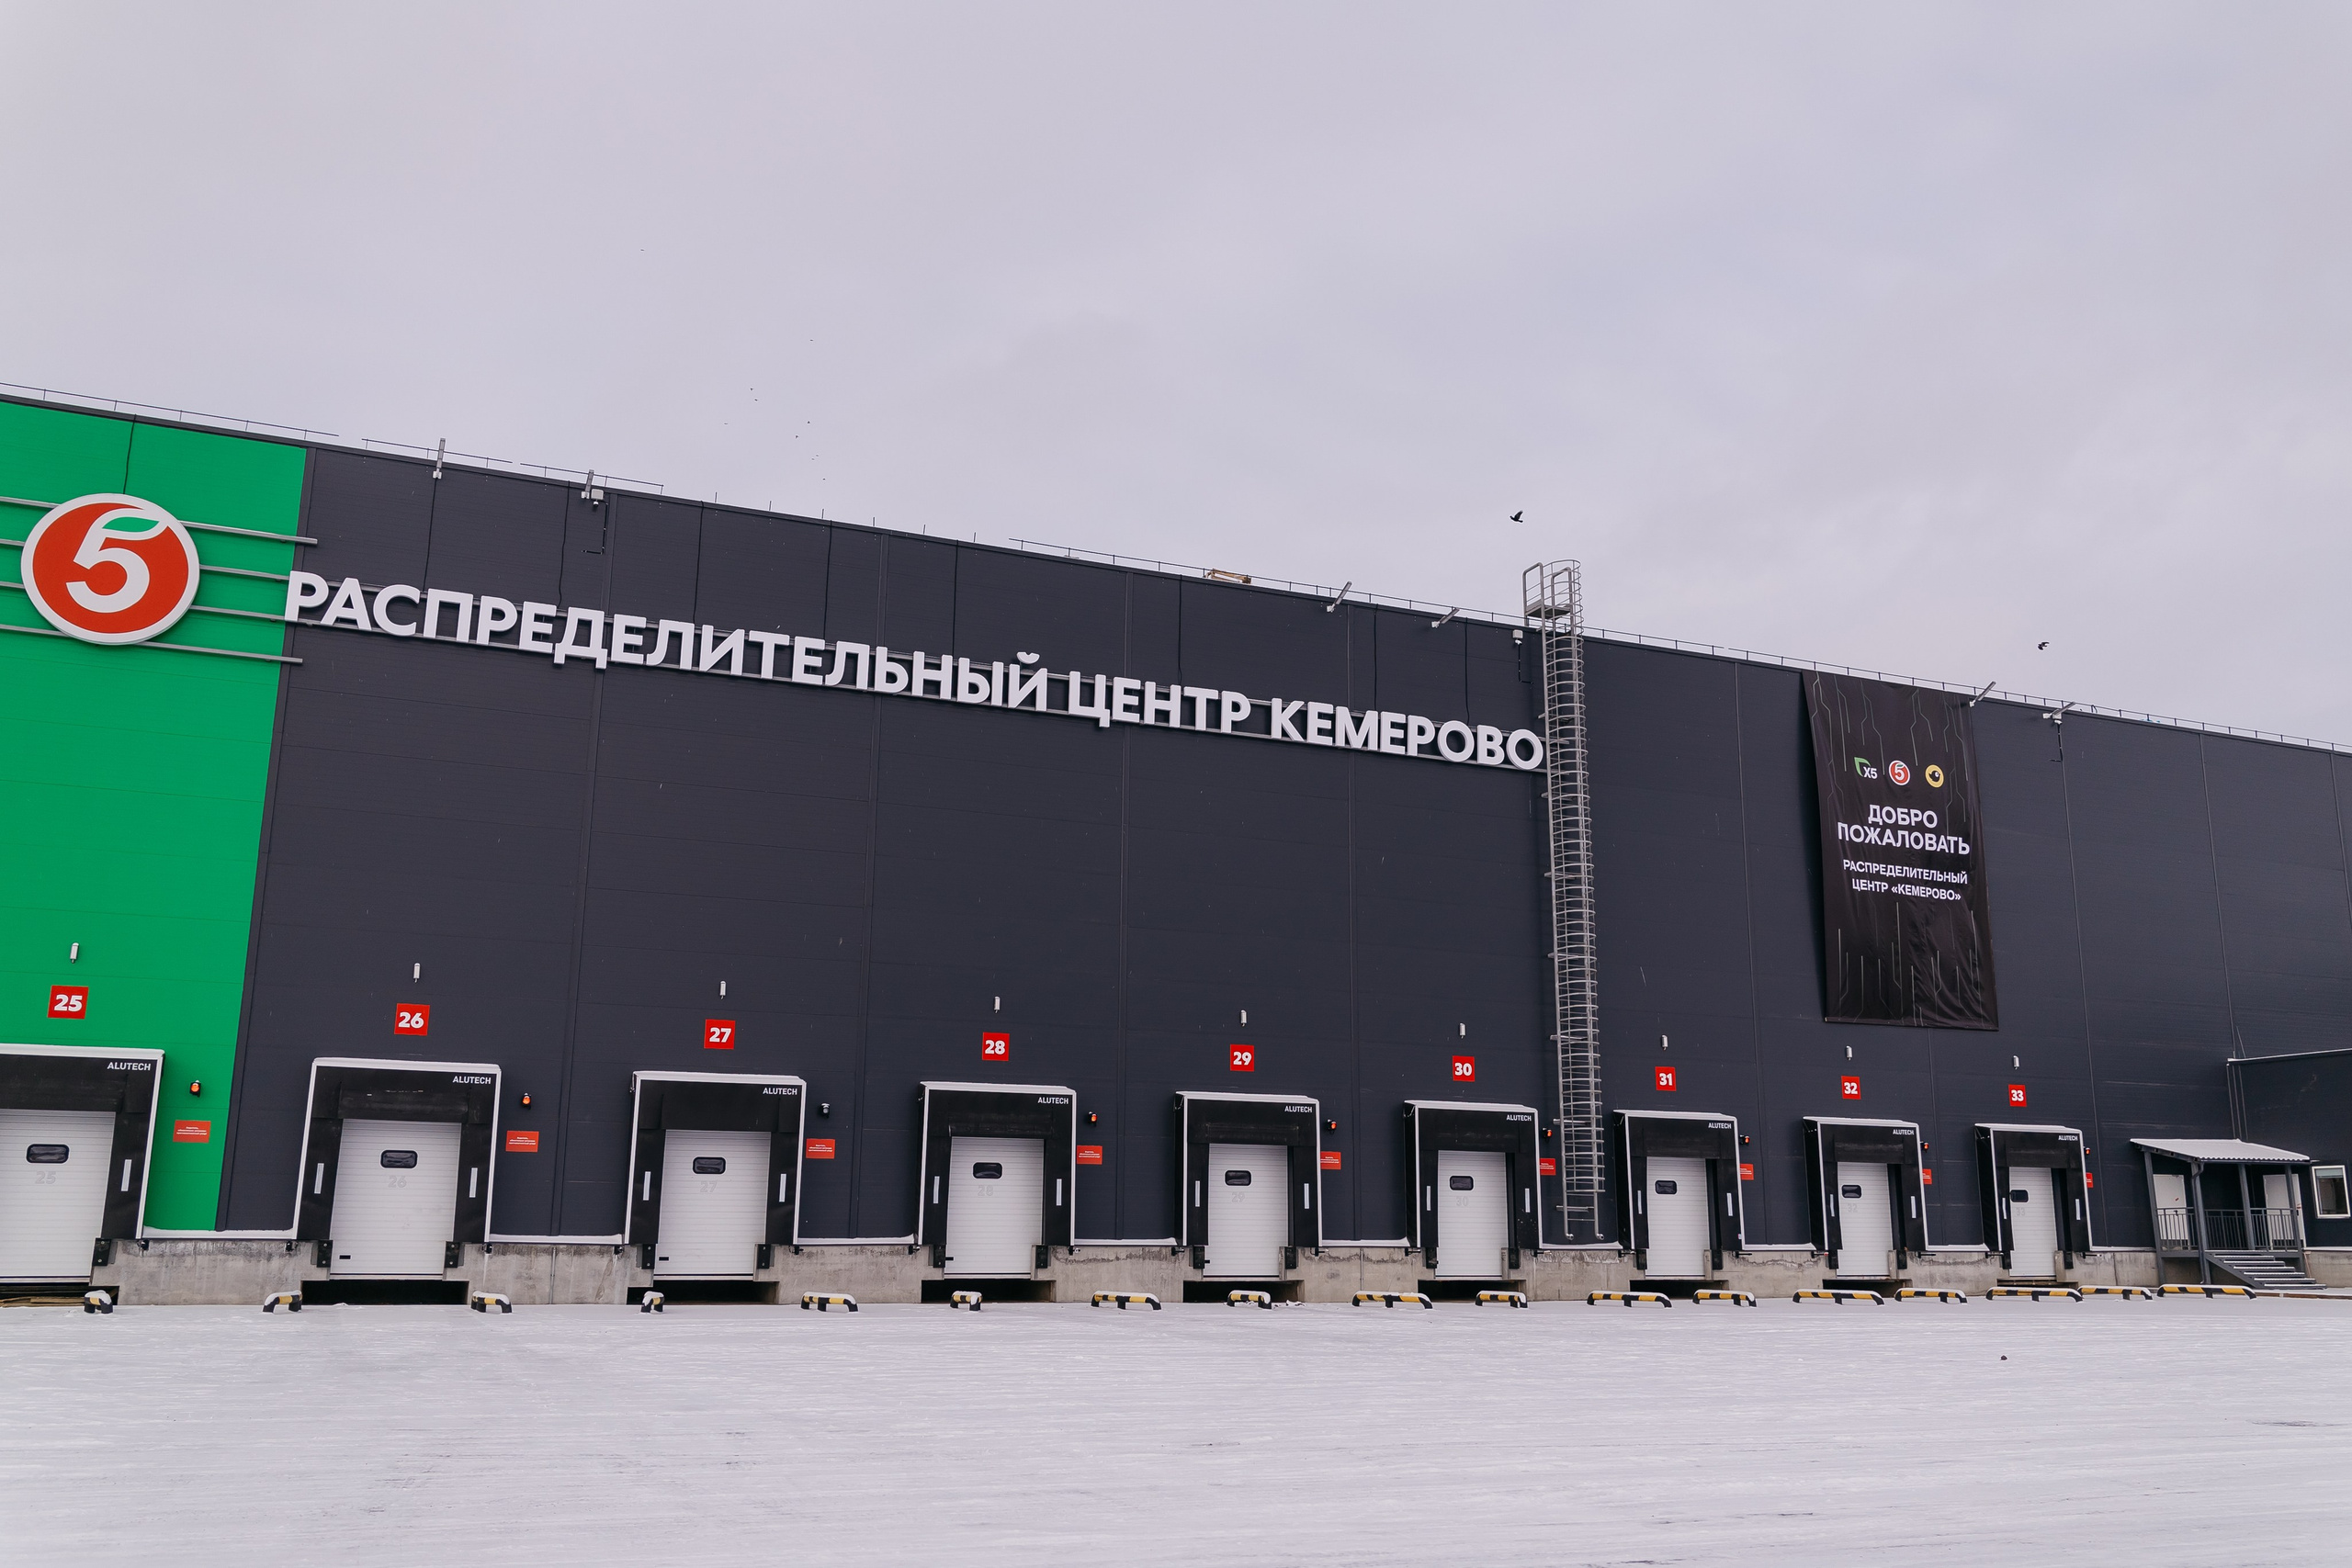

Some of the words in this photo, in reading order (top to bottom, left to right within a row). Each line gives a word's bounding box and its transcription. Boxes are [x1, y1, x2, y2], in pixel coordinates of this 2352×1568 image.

[65, 507, 168, 614] 5
[284, 570, 1047, 712] РАСПРЕДЕЛИТЕЛЬНЫЙ
[1069, 671, 1251, 733] ЦЕНТР
[1271, 697, 1544, 770] КЕМЕРОВО
[1862, 766, 1878, 780] X5
[1868, 804, 1938, 829] ДОБРО
[1838, 822, 1970, 855] ПОЖАЛОВАТЬ
[1843, 859, 1968, 885] РАСПРЕДЕЛИТЕЛЬНЫЙ
[1851, 878, 1889, 893] ЦЕНТР
[1891, 883, 1962, 901] «КЕМЕРОВО»
[53, 994, 83, 1011] 25
[398, 1011, 424, 1029] 26
[708, 1027, 732, 1043] 27
[984, 1039, 1006, 1055] 28
[107, 1061, 152, 1071] ALUTECH
[1233, 1051, 1252, 1066] 29
[1454, 1062, 1473, 1077] 30
[452, 1075, 492, 1085] ALUTECH
[1659, 1072, 1673, 1086] 31
[763, 1087, 797, 1096] ALUTECH
[1844, 1081, 1859, 1095] 32
[2010, 1089, 2024, 1102] 33
[1037, 1096, 1069, 1105] ALUTECH
[1284, 1105, 1313, 1113] ALUTECH
